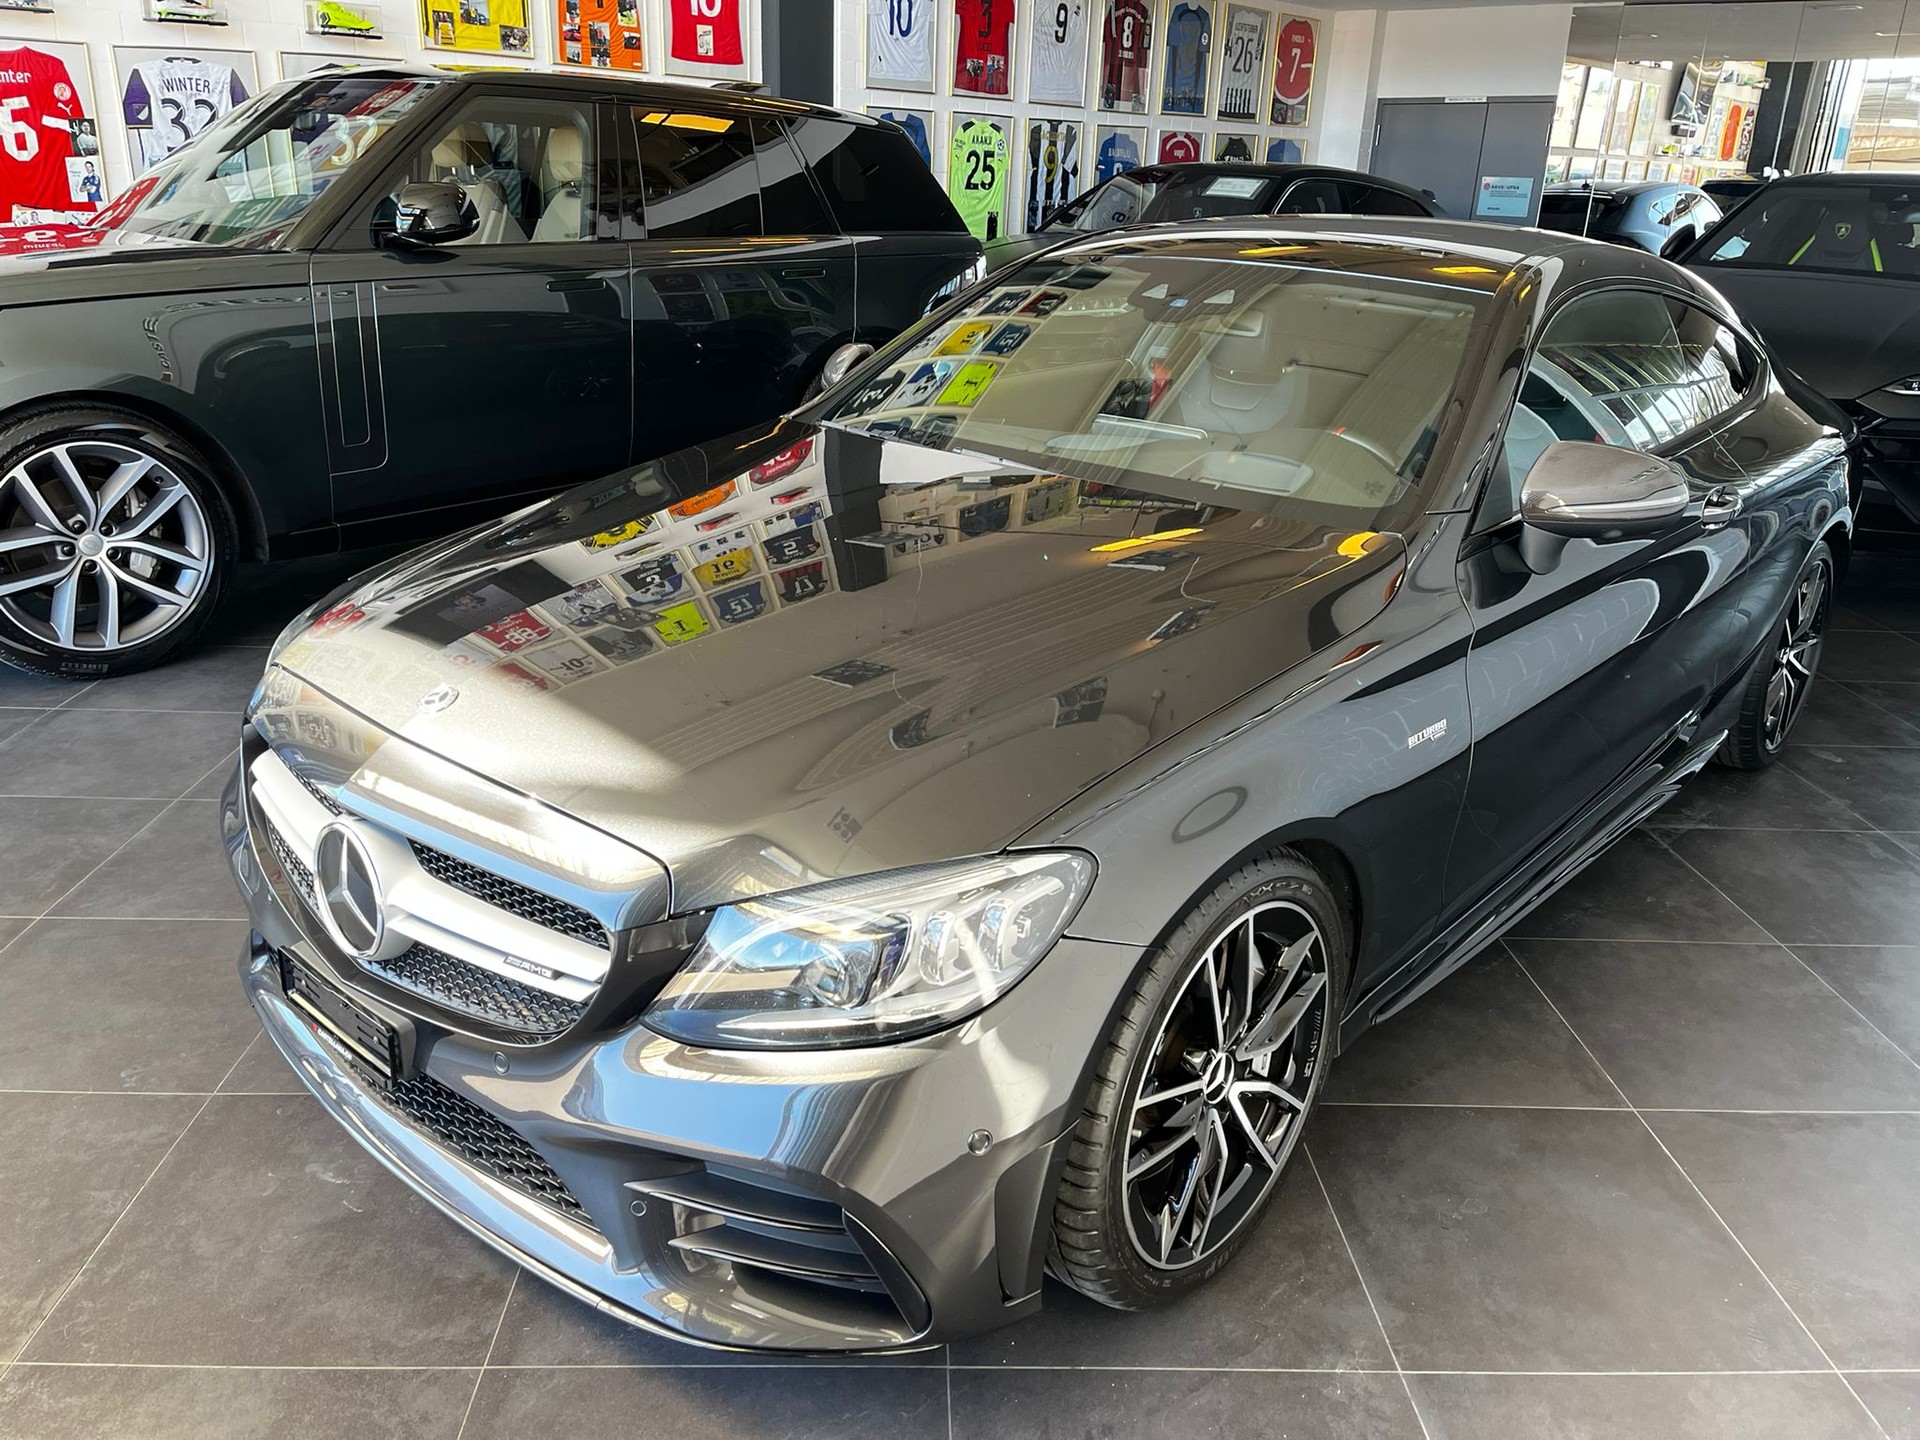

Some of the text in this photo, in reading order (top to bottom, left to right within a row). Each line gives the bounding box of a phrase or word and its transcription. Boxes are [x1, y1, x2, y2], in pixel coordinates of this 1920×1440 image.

[1055, 3, 1068, 43] 9
[1122, 15, 1134, 48] 8
[1232, 36, 1254, 74] 26
[1290, 47, 1302, 83] 7
[0, 69, 32, 83] nter
[162, 77, 211, 93] WINTER
[971, 134, 993, 146] AKANJI
[964, 149, 996, 191] 25
[1043, 145, 1059, 184] 9
[1408, 719, 1447, 747] BITURBO
